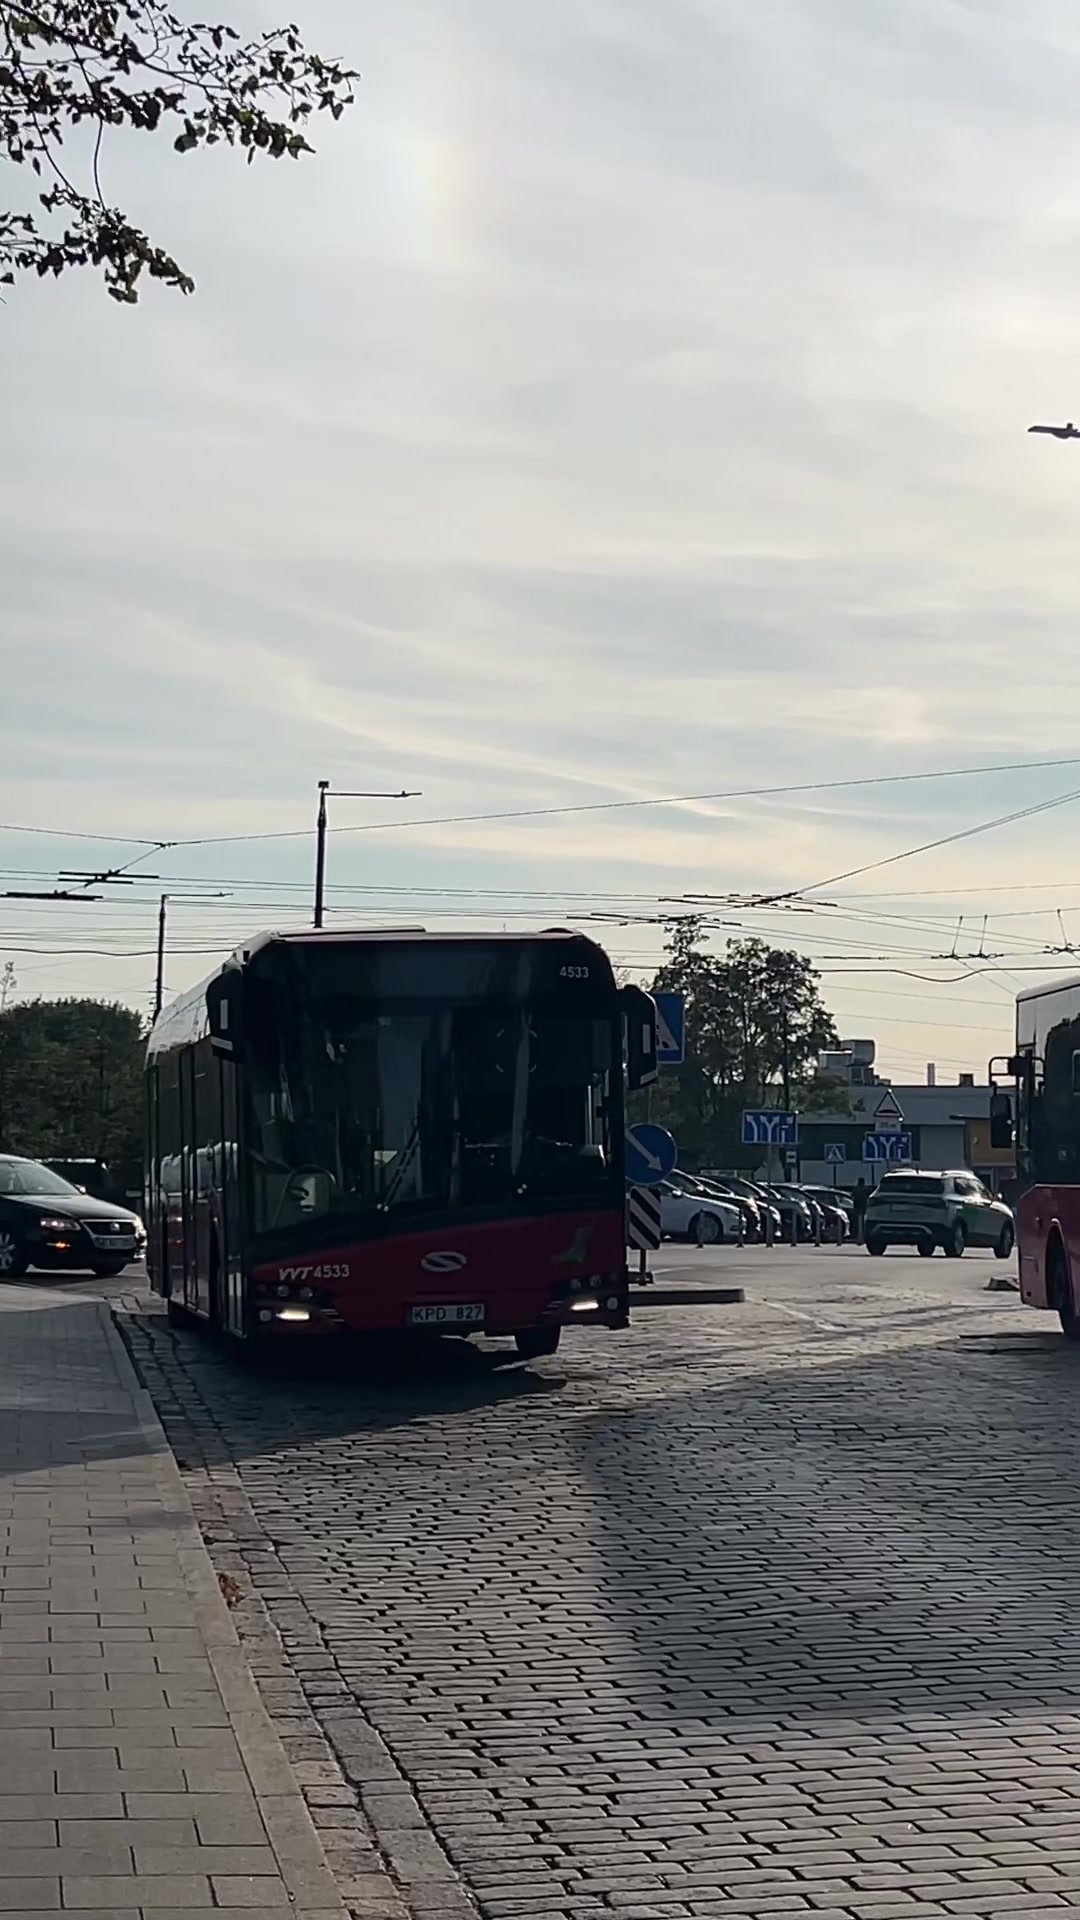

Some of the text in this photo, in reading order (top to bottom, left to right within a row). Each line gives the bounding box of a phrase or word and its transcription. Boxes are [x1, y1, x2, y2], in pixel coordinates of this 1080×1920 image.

[559, 966, 589, 978] 4533
[313, 1264, 350, 1279] 4533
[414, 1305, 482, 1321] KPD 827
